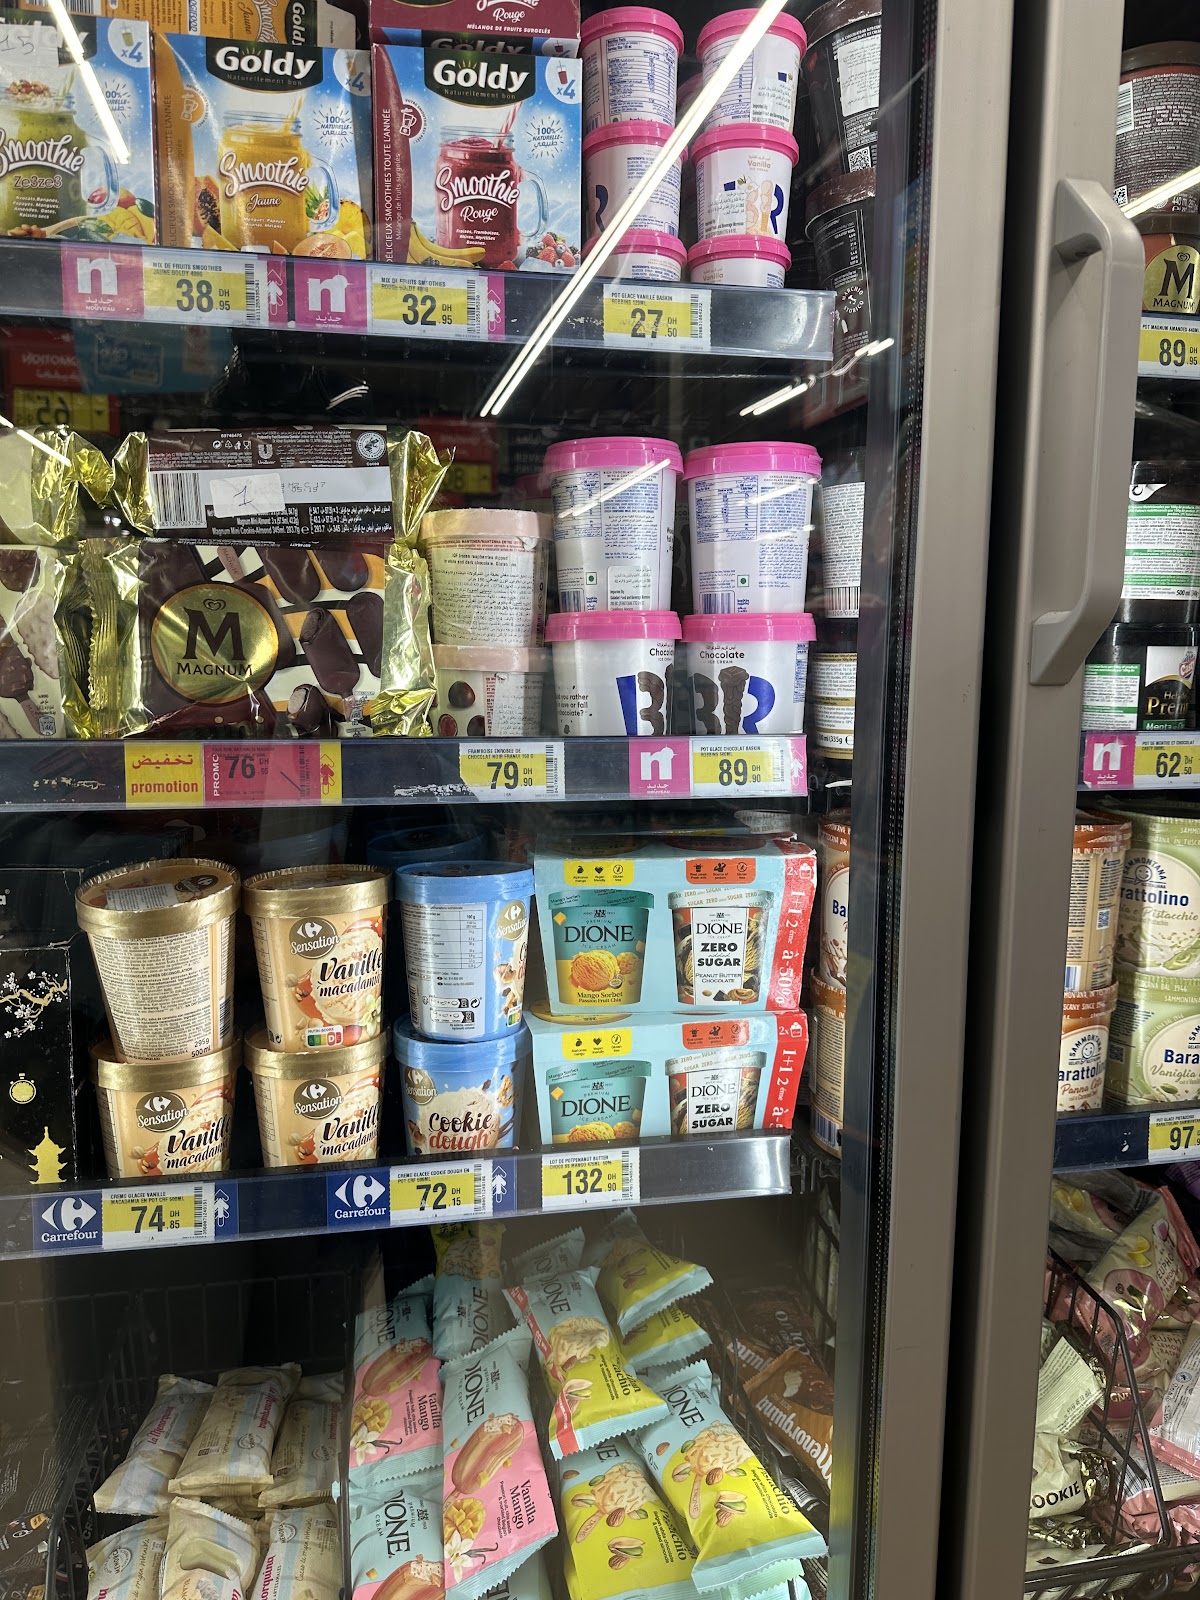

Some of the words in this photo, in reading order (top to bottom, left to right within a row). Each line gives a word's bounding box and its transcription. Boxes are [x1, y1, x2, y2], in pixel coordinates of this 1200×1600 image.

[492, 7, 525, 22] Rouge
[121, 42, 144, 63] x4
[215, 46, 317, 79] Goldy
[433, 59, 530, 93] Goldy
[444, 88, 499, 99] Naturellement
[556, 79, 576, 100] x4
[383, 143, 392, 172] TOUTE
[14, 175, 63, 189] Ze3ze3
[220, 151, 310, 197] Smoothie
[436, 166, 520, 211] Smoothie
[384, 172, 393, 222] SMOOTHIES
[460, 205, 499, 223] Rouge
[176, 278, 214, 312] 38
[218, 288, 230, 297] DH
[215, 300, 231, 310] .95
[402, 293, 437, 326] 32
[441, 303, 452, 312] DH
[1152, 297, 1195, 311] MAGNUM
[438, 314, 453, 325] .95
[630, 307, 663, 338] 27
[667, 316, 677, 325] DH
[664, 327, 678, 338] .50
[1159, 338, 1186, 367] 89
[1189, 346, 1198, 354] DH
[184, 606, 245, 661] M
[700, 650, 745, 660] Chocolate
[175, 662, 253, 678] MAGNUM
[569, 693, 589, 701] rather
[577, 701, 589, 709] fall
[132, 753, 194, 769] تخفيض
[224, 755, 256, 779] 76
[751, 764, 761, 772] DH
[1156, 752, 1182, 779] 62
[1184, 755, 1194, 765] DH
[486, 761, 519, 790] 79
[523, 767, 533, 775] DH
[718, 758, 749, 787] 89
[749, 775, 762, 783] .90
[131, 779, 199, 796] promotion
[520, 777, 533, 787] .90
[744, 891, 758, 899] ZERO
[786, 889, 806, 915] 1+1
[1119, 886, 1190, 907] rattolino
[564, 925, 635, 943] DIONE
[695, 922, 743, 936] DIONE
[290, 933, 340, 955] Sensation
[700, 942, 738, 953] ZERO
[697, 957, 741, 968] SUGAR
[577, 991, 600, 1000] Mango
[601, 991, 624, 999] Sorbet
[1173, 983, 1188, 992] 1946
[778, 1025, 790, 1036] 2x
[191, 1045, 211, 1059] 500ml
[1163, 1049, 1200, 1065] Bara
[778, 1049, 797, 1073] 1+1
[691, 1082, 736, 1098] DIONE
[294, 1094, 343, 1116] Sensation
[560, 1095, 632, 1118] DIONE
[695, 1103, 731, 1115] ZERO
[137, 1106, 188, 1129] Sensation
[428, 1111, 492, 1133] Cookie
[691, 1117, 734, 1129] SUGAR
[428, 1129, 491, 1151] dough
[1169, 1125, 1195, 1151] 97
[562, 1167, 603, 1195] 132
[604, 1182, 617, 1193] .90
[416, 1182, 447, 1212] 72
[451, 1187, 461, 1195] DH
[448, 1196, 461, 1207] .15
[131, 1204, 166, 1234] 74
[169, 1210, 180, 1218] DH
[334, 1206, 387, 1219] Carrefour
[166, 1219, 180, 1230] .85
[41, 1229, 98, 1243] Carrefour
[417, 1394, 430, 1432] Mango
[509, 1485, 525, 1531] Mango
[520, 1479, 537, 1525] Vanilla
